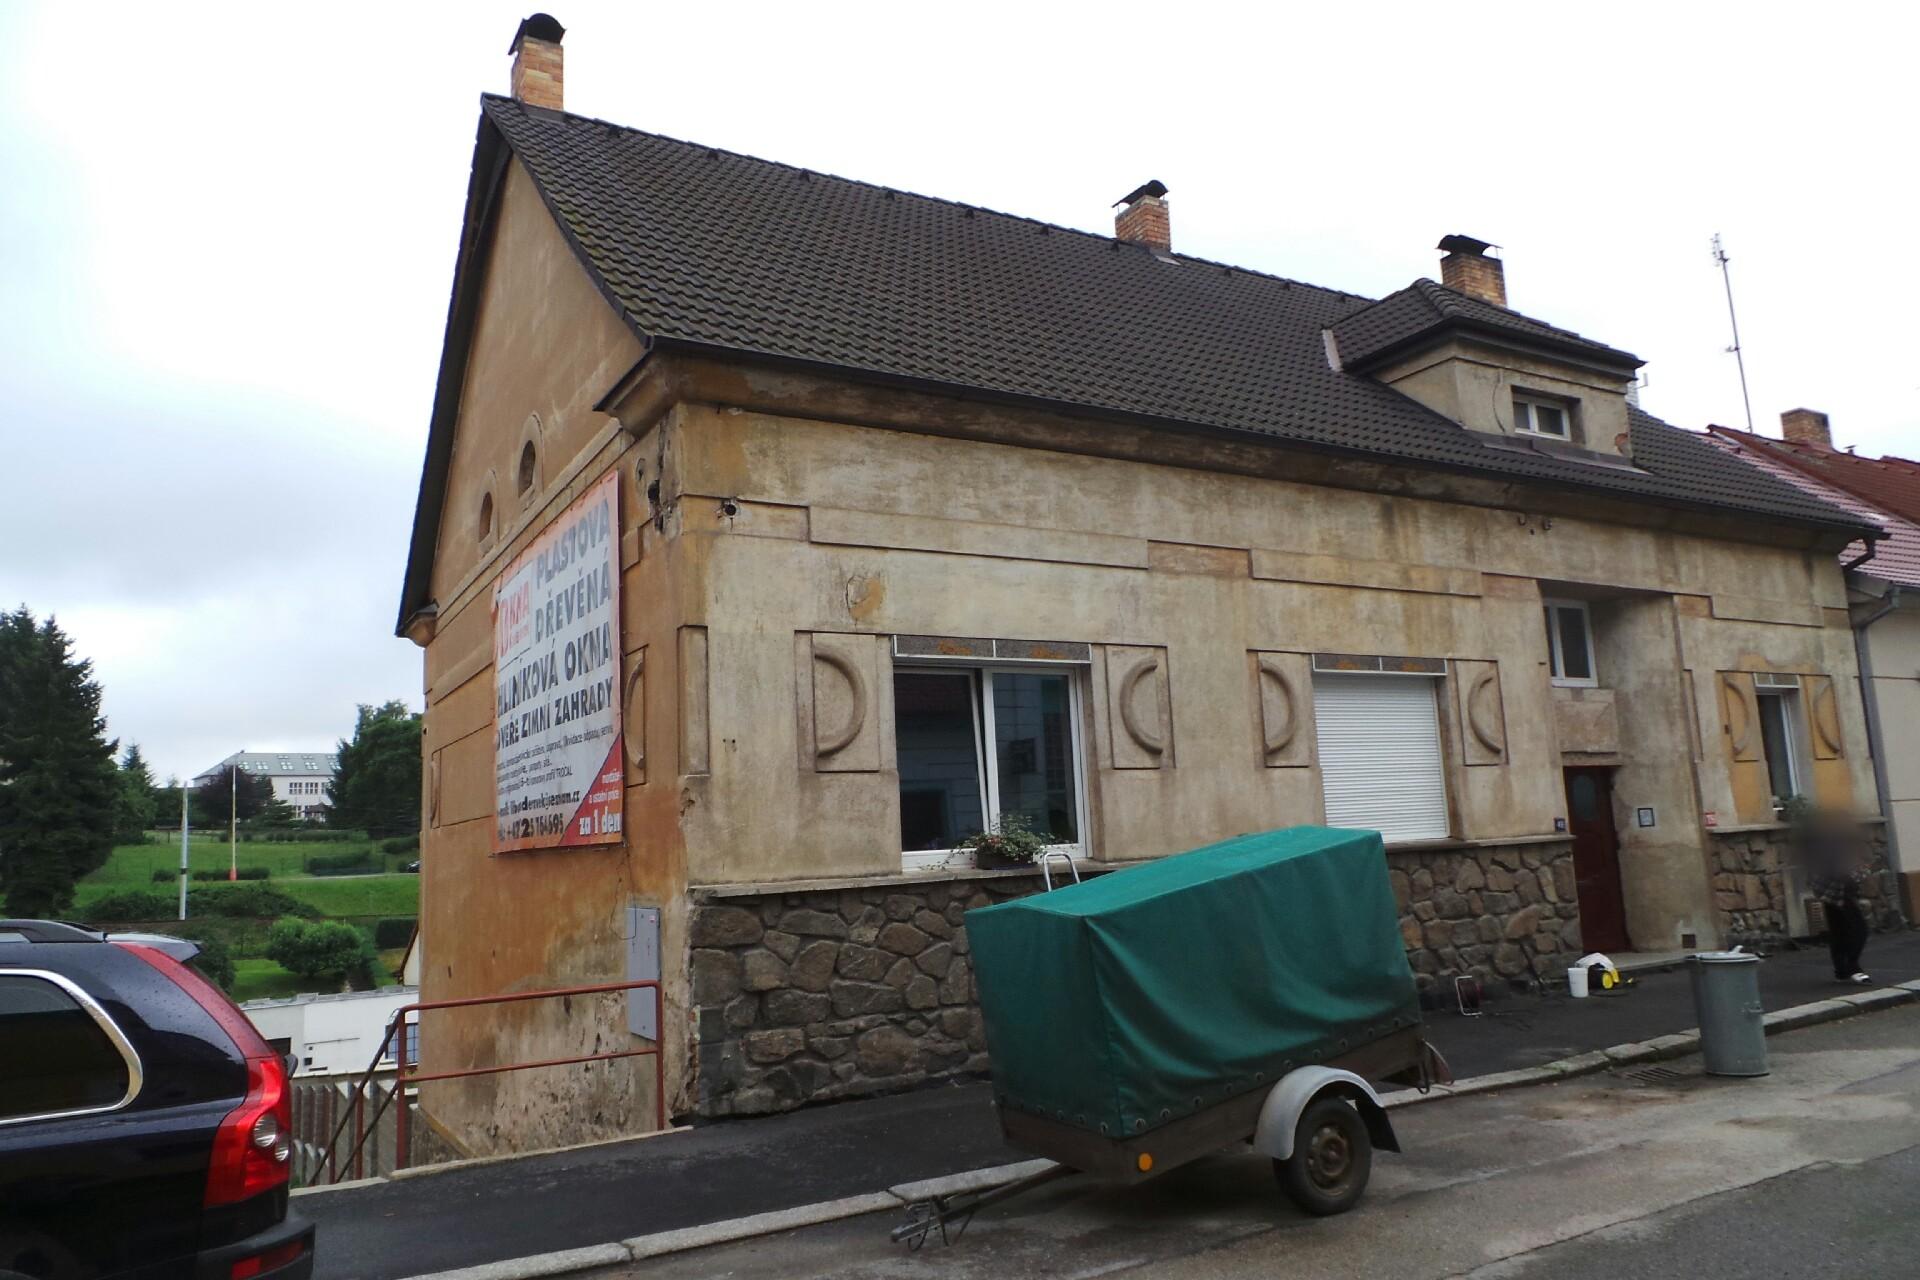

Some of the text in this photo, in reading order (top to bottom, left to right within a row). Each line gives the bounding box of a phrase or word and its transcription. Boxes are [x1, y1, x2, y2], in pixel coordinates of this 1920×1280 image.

[535, 546, 610, 644] DŘEVĚNÁ
[565, 621, 612, 681] OKNA
[520, 693, 550, 739] ZIMNÍ
[555, 676, 614, 726] ZAHRADY
[579, 805, 621, 836] za 1 den
